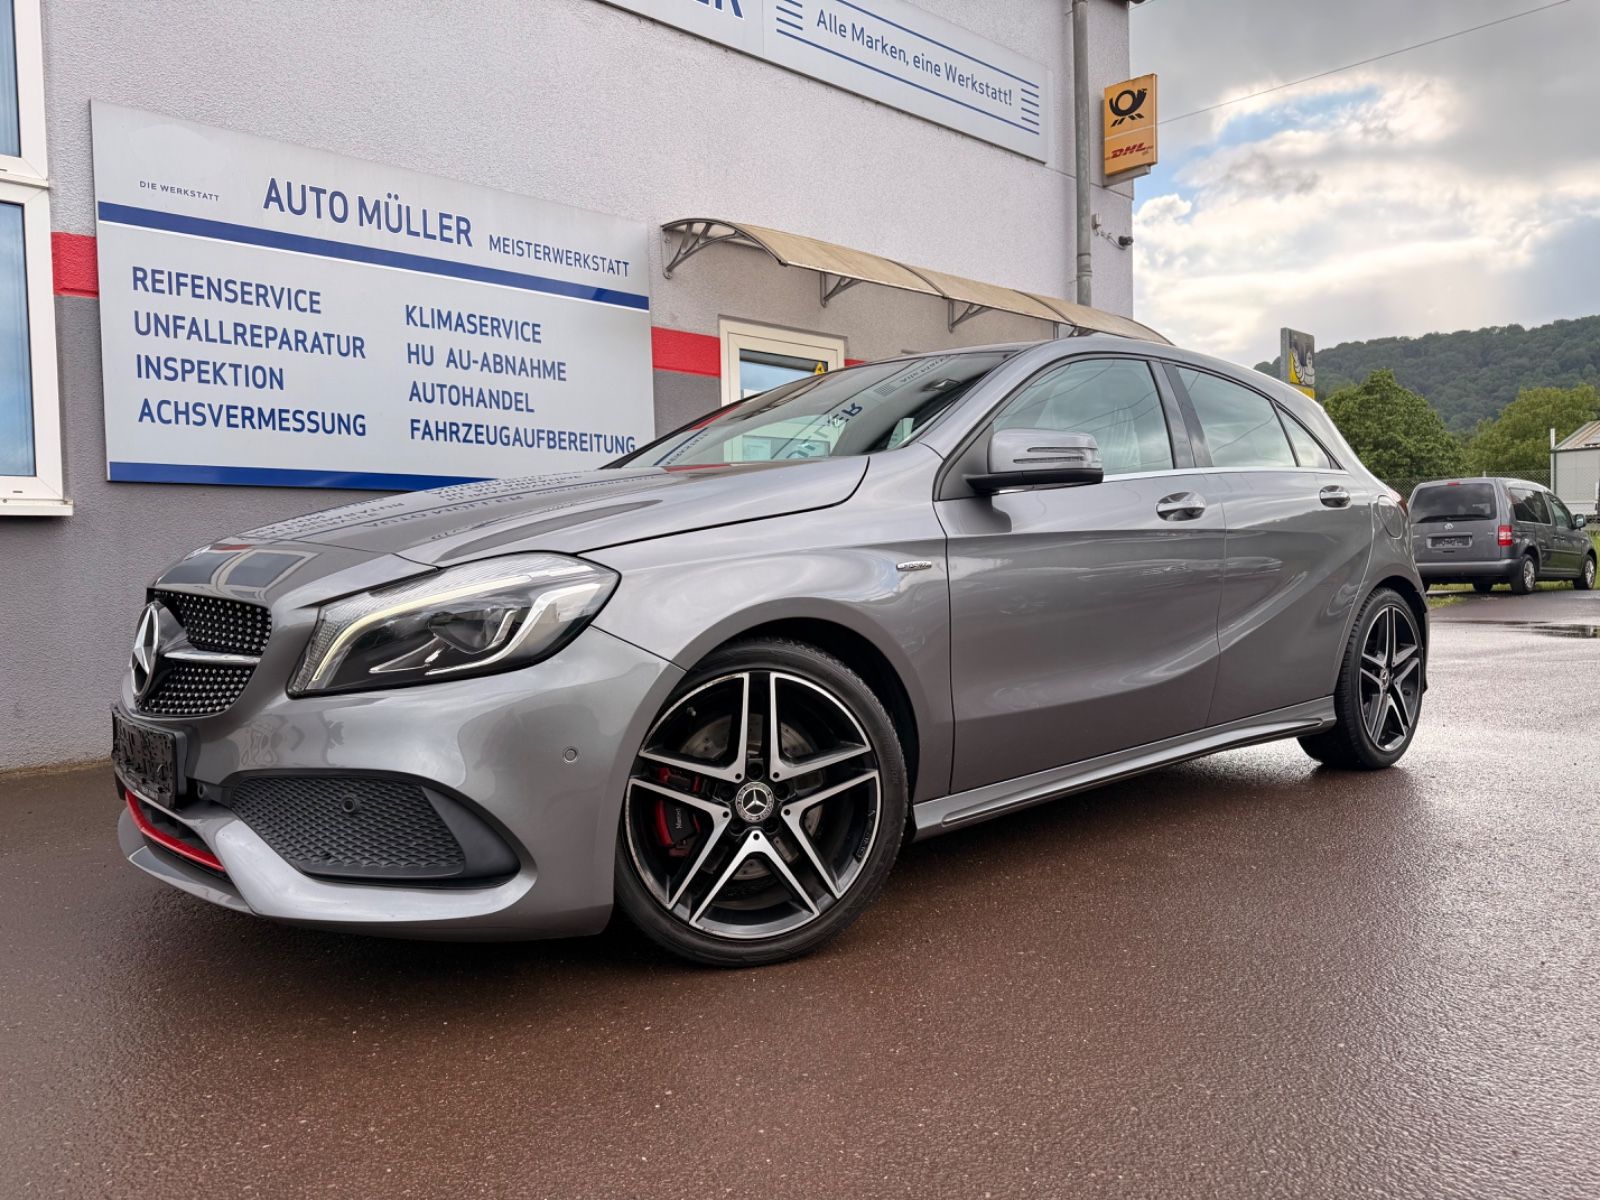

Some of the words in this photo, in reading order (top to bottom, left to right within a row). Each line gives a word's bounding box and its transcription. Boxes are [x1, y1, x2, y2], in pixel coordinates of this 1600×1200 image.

[816, 9, 847, 38] Alle
[851, 23, 910, 66] Marken,
[912, 55, 941, 77] eine
[945, 63, 1013, 106] Werkstatt!
[1110, 142, 1146, 160] DHL
[139, 180, 158, 193] DIE
[160, 184, 220, 202] WERKSTATT
[263, 178, 349, 224] AUTO
[358, 192, 472, 247] MÜLLER
[488, 234, 630, 278] MEISTERWERKSTATT
[133, 266, 321, 314] REIFENSERVICE
[134, 311, 366, 359] UNFALLREPARATUR
[406, 304, 542, 343] KLIMASERVICE
[137, 354, 285, 391] INSPEKTION
[407, 343, 435, 366] HU
[446, 348, 567, 382] AU-ABNAHME
[409, 381, 536, 413] AUTOHANDEL
[138, 398, 367, 437] ACHSVERMESSUNG
[410, 418, 636, 455] FAHRZEUGAUFBEREITUNG
